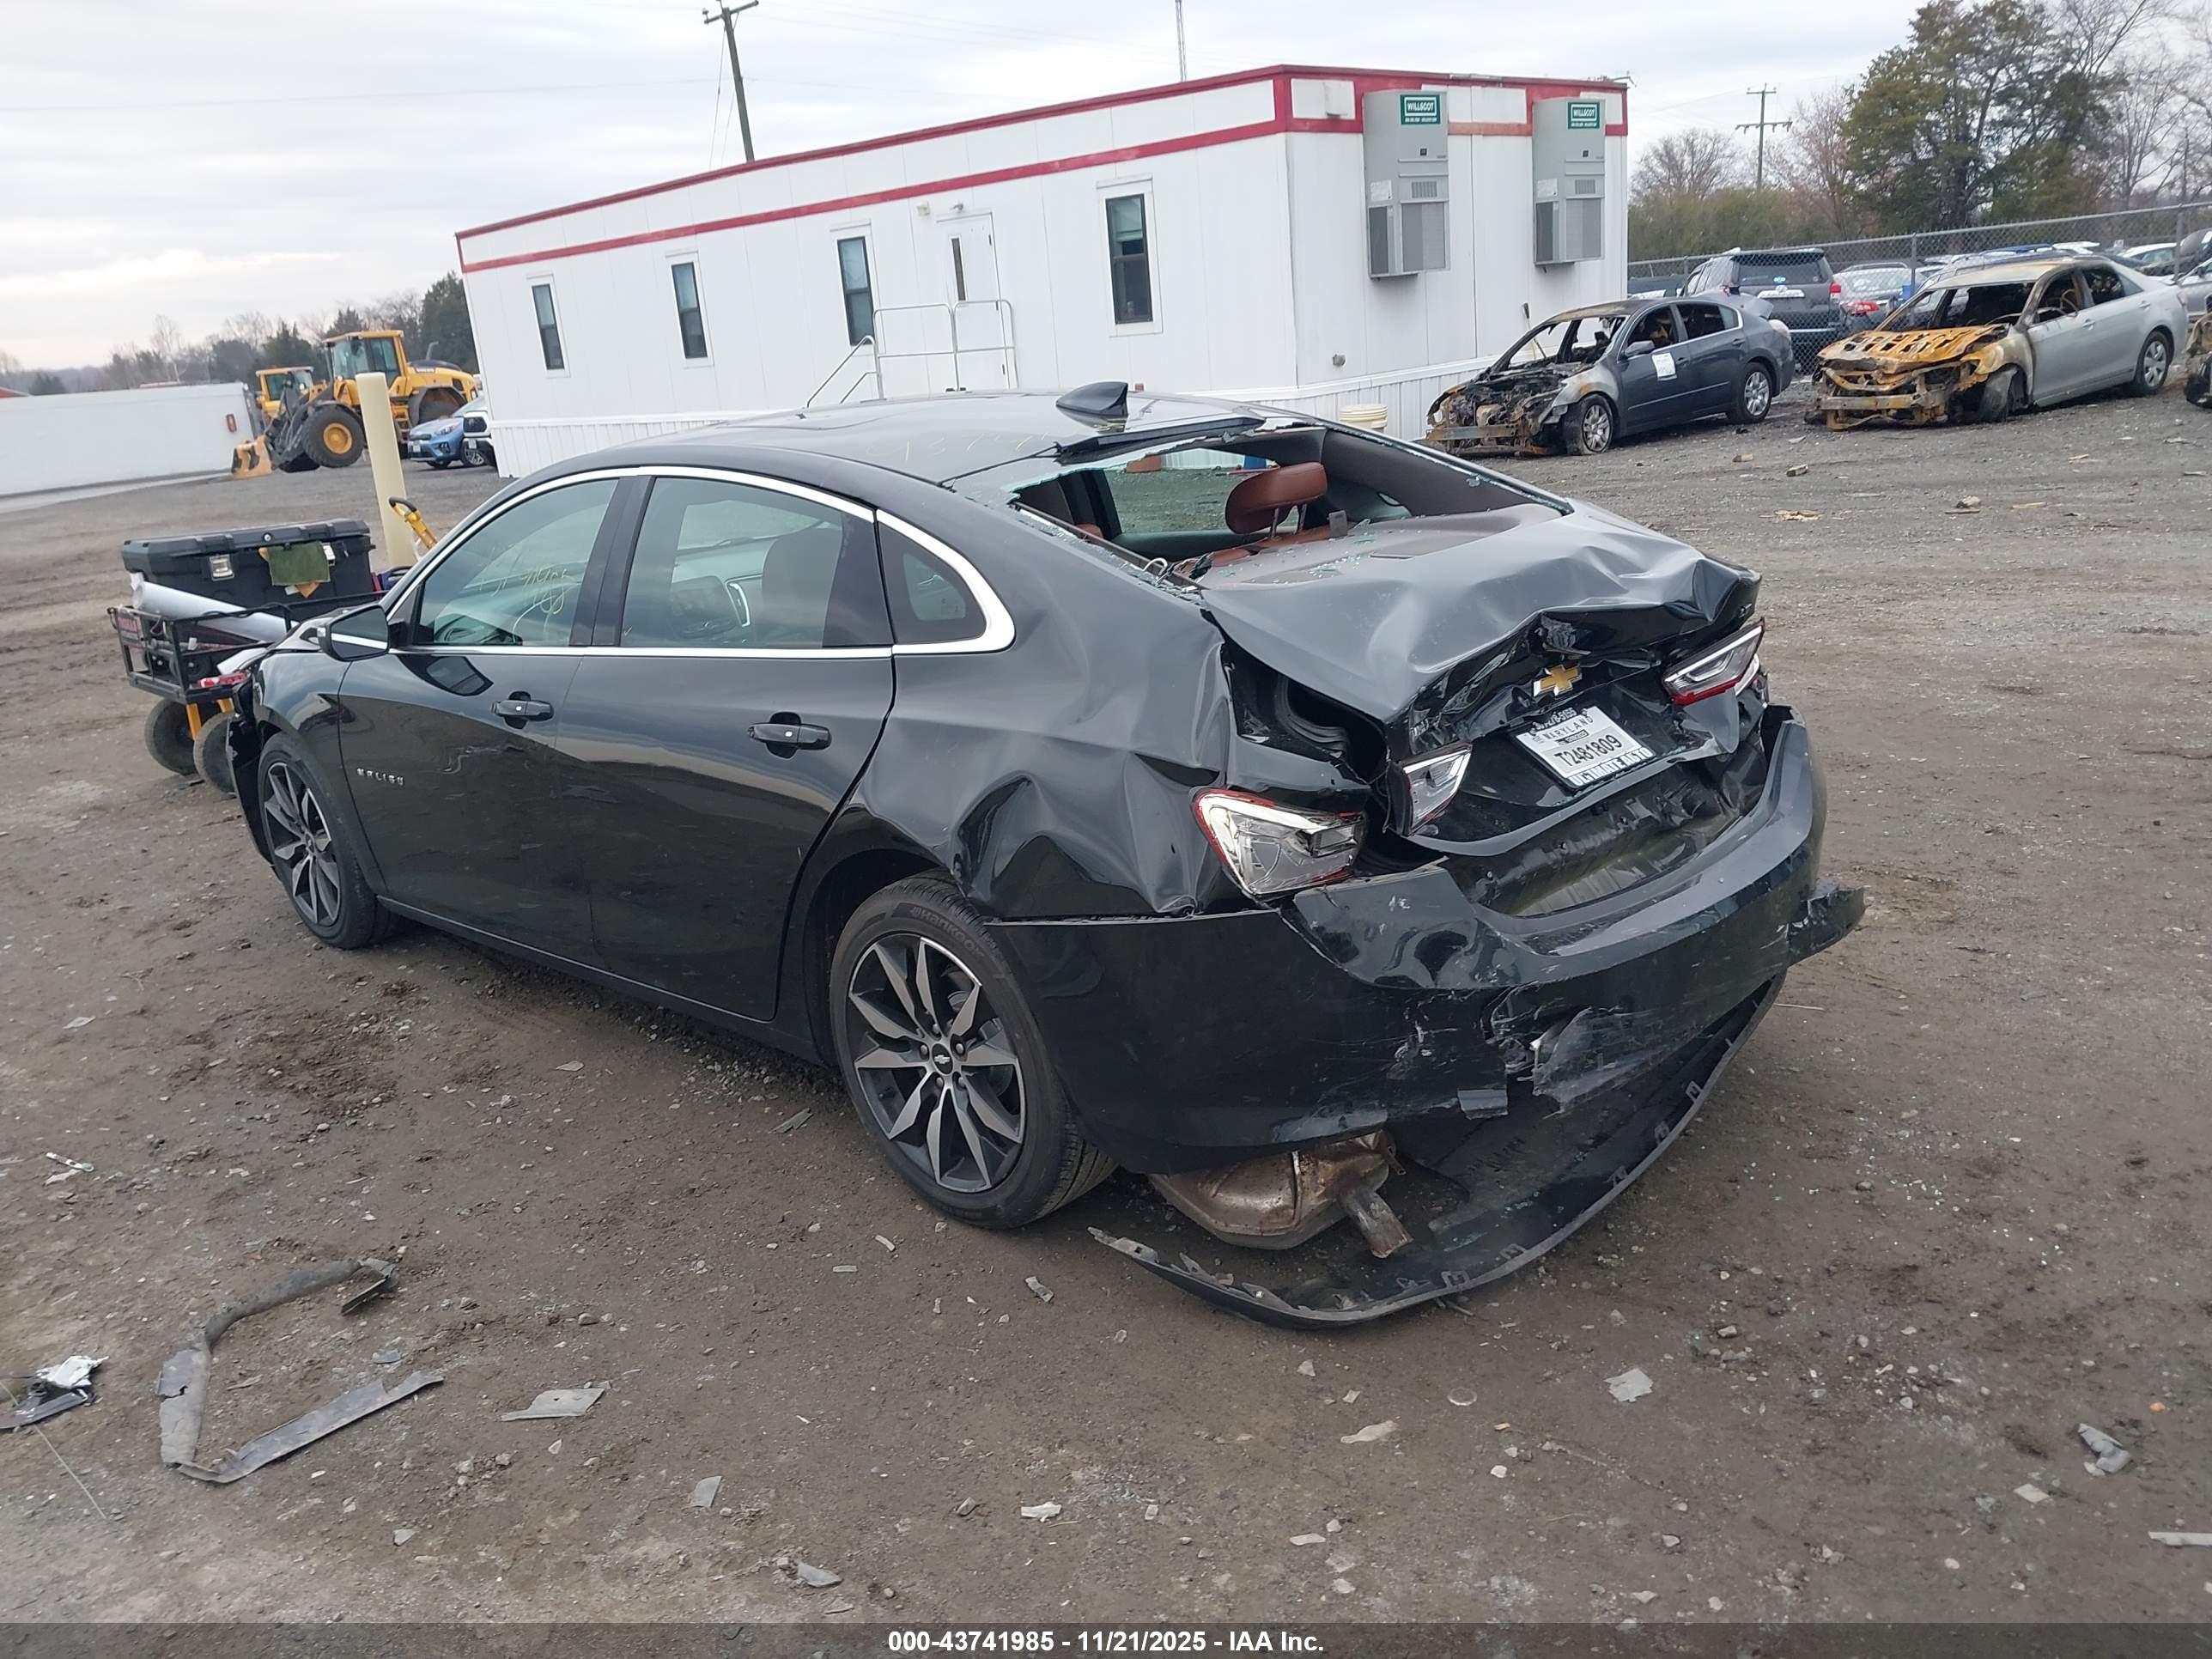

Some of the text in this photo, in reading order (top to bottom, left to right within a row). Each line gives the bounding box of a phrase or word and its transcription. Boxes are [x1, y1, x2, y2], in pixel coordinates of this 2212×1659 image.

[1407, 101, 1434, 112] WILLSCOT
[1573, 108, 1595, 117] WILLSCOT
[1542, 715, 1594, 739] MARYLAND
[1554, 734, 1623, 767] T2481809
[1568, 746, 1655, 786] ULTIMATE AUTO
